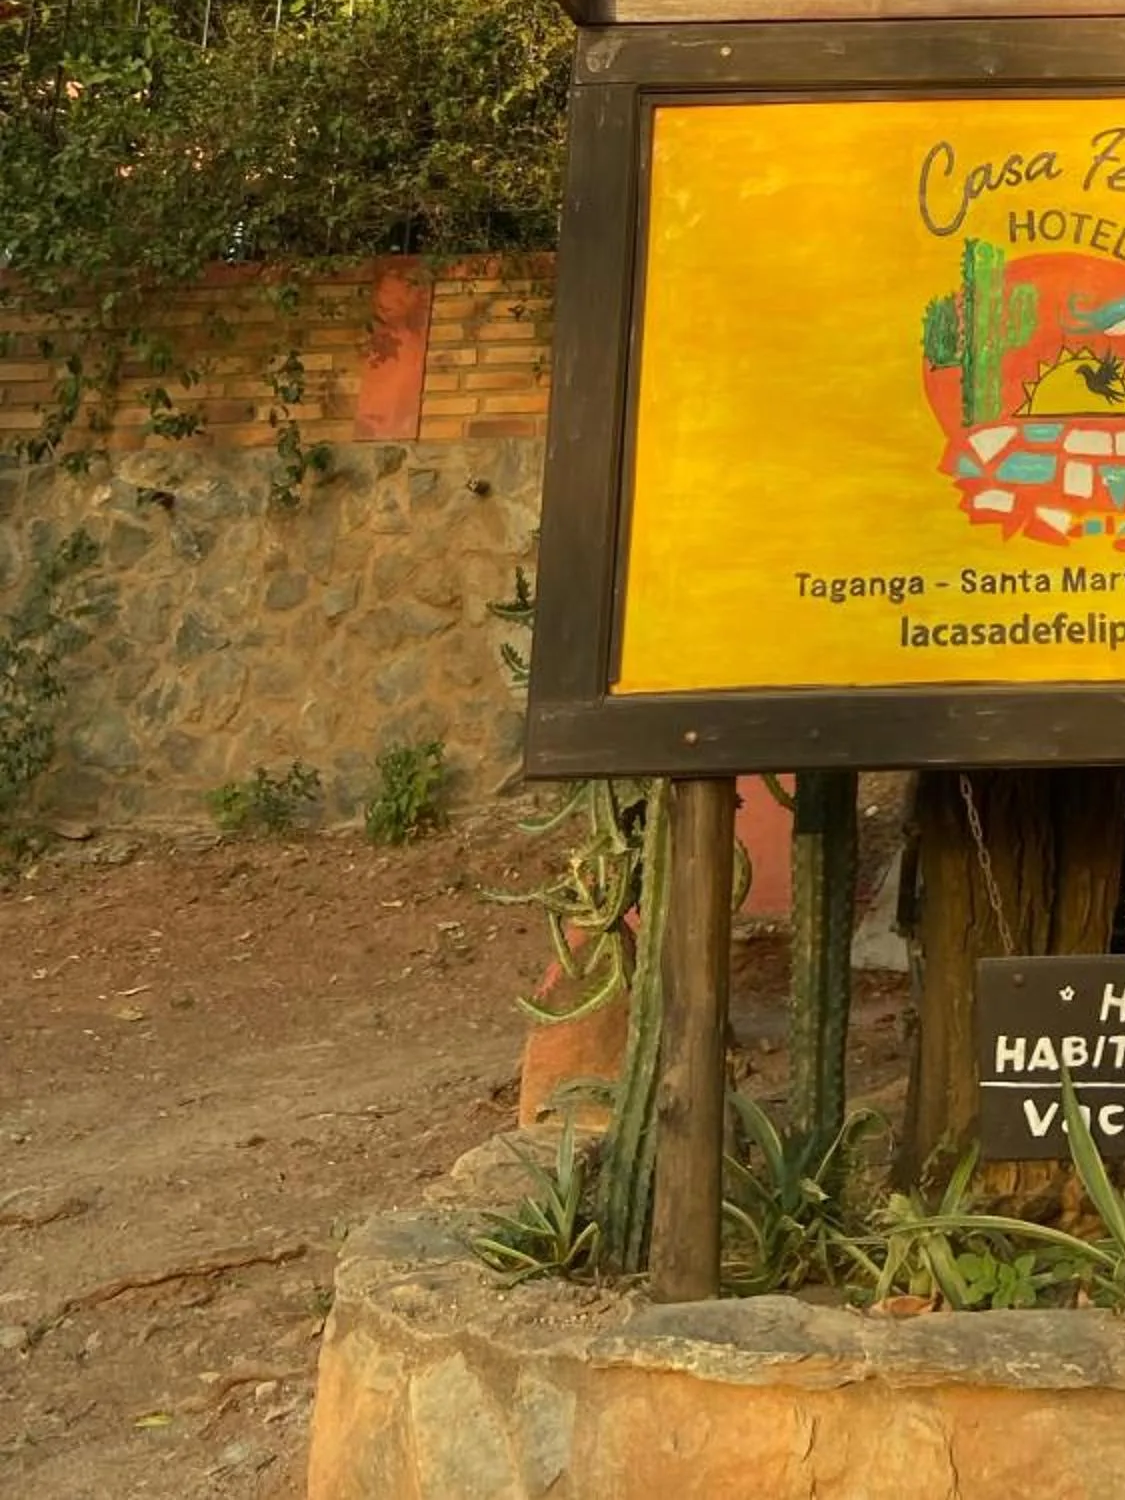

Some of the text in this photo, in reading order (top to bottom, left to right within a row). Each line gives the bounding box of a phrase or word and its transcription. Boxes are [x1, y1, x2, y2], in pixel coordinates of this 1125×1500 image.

[919, 141, 1063, 237] Casa
[795, 572, 925, 603] Taganga
[960, 569, 1050, 594] Santa
